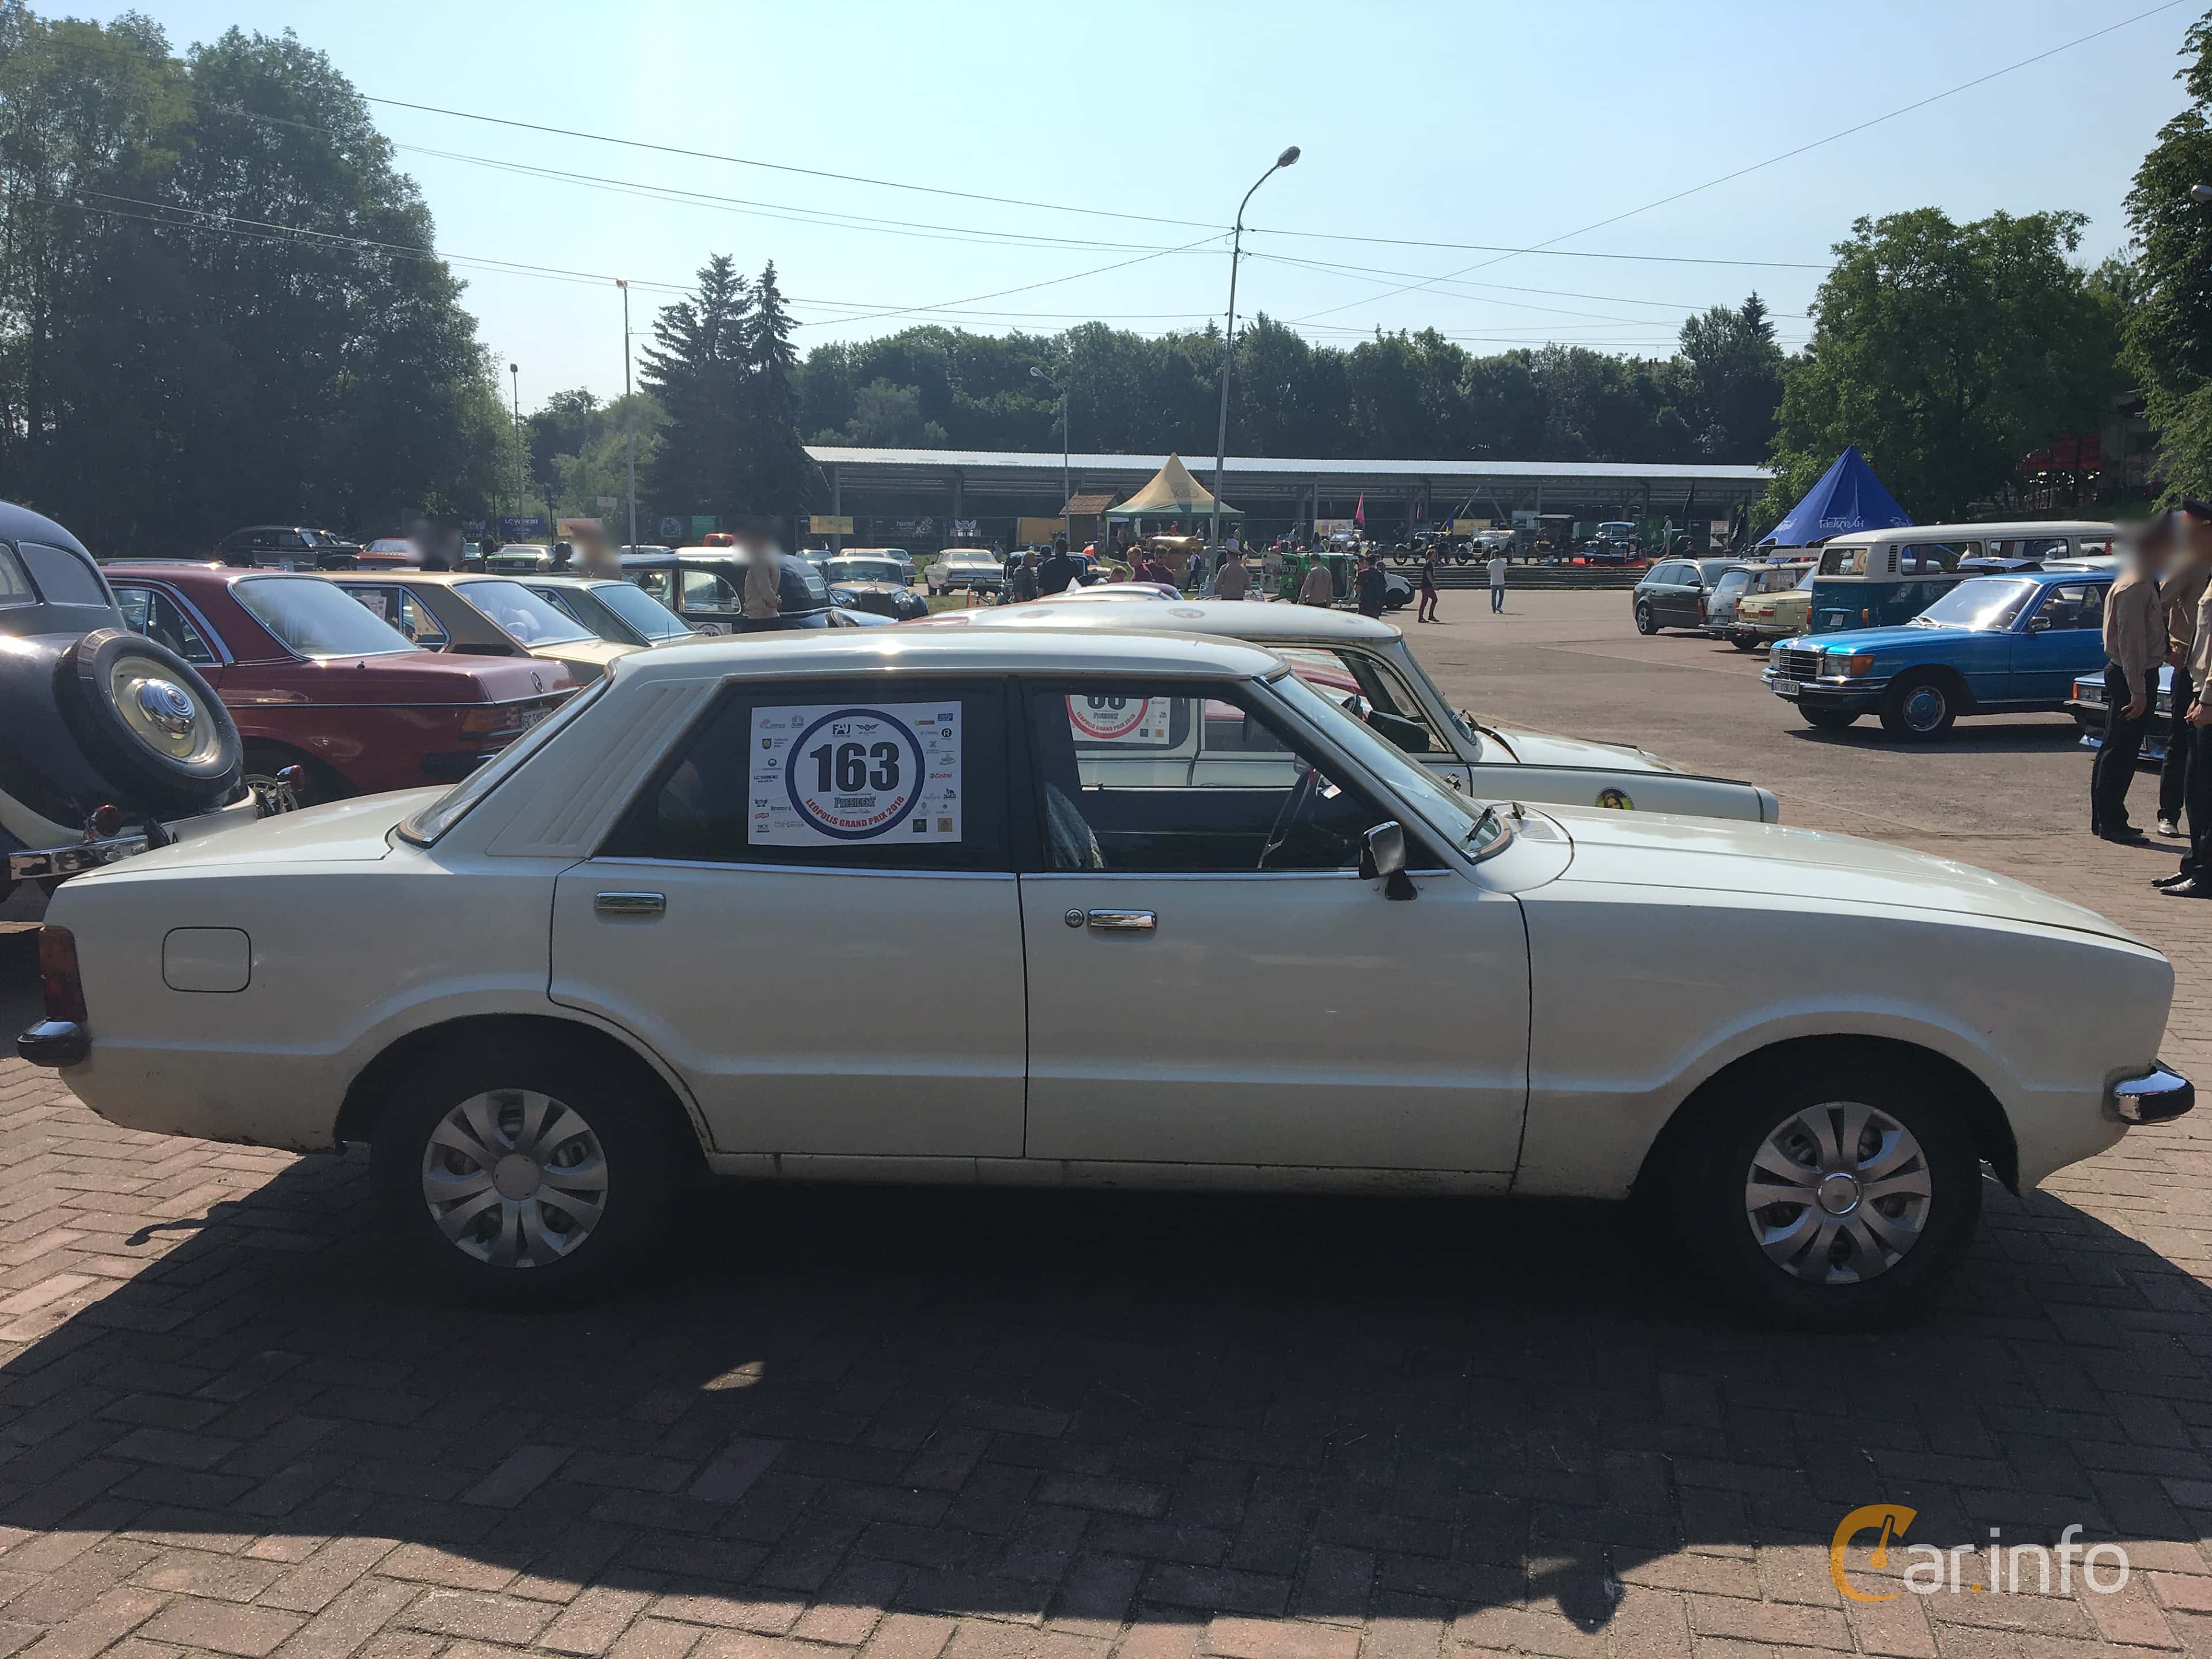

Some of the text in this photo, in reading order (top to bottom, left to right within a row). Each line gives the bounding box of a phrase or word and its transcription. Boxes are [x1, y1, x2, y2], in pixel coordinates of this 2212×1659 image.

[810, 742, 900, 792] 163
[805, 798, 839, 825] LEOPOLIS
[839, 819, 868, 828] GRAND
[868, 812, 888, 825] PRIX
[887, 796, 905, 815] 2018
